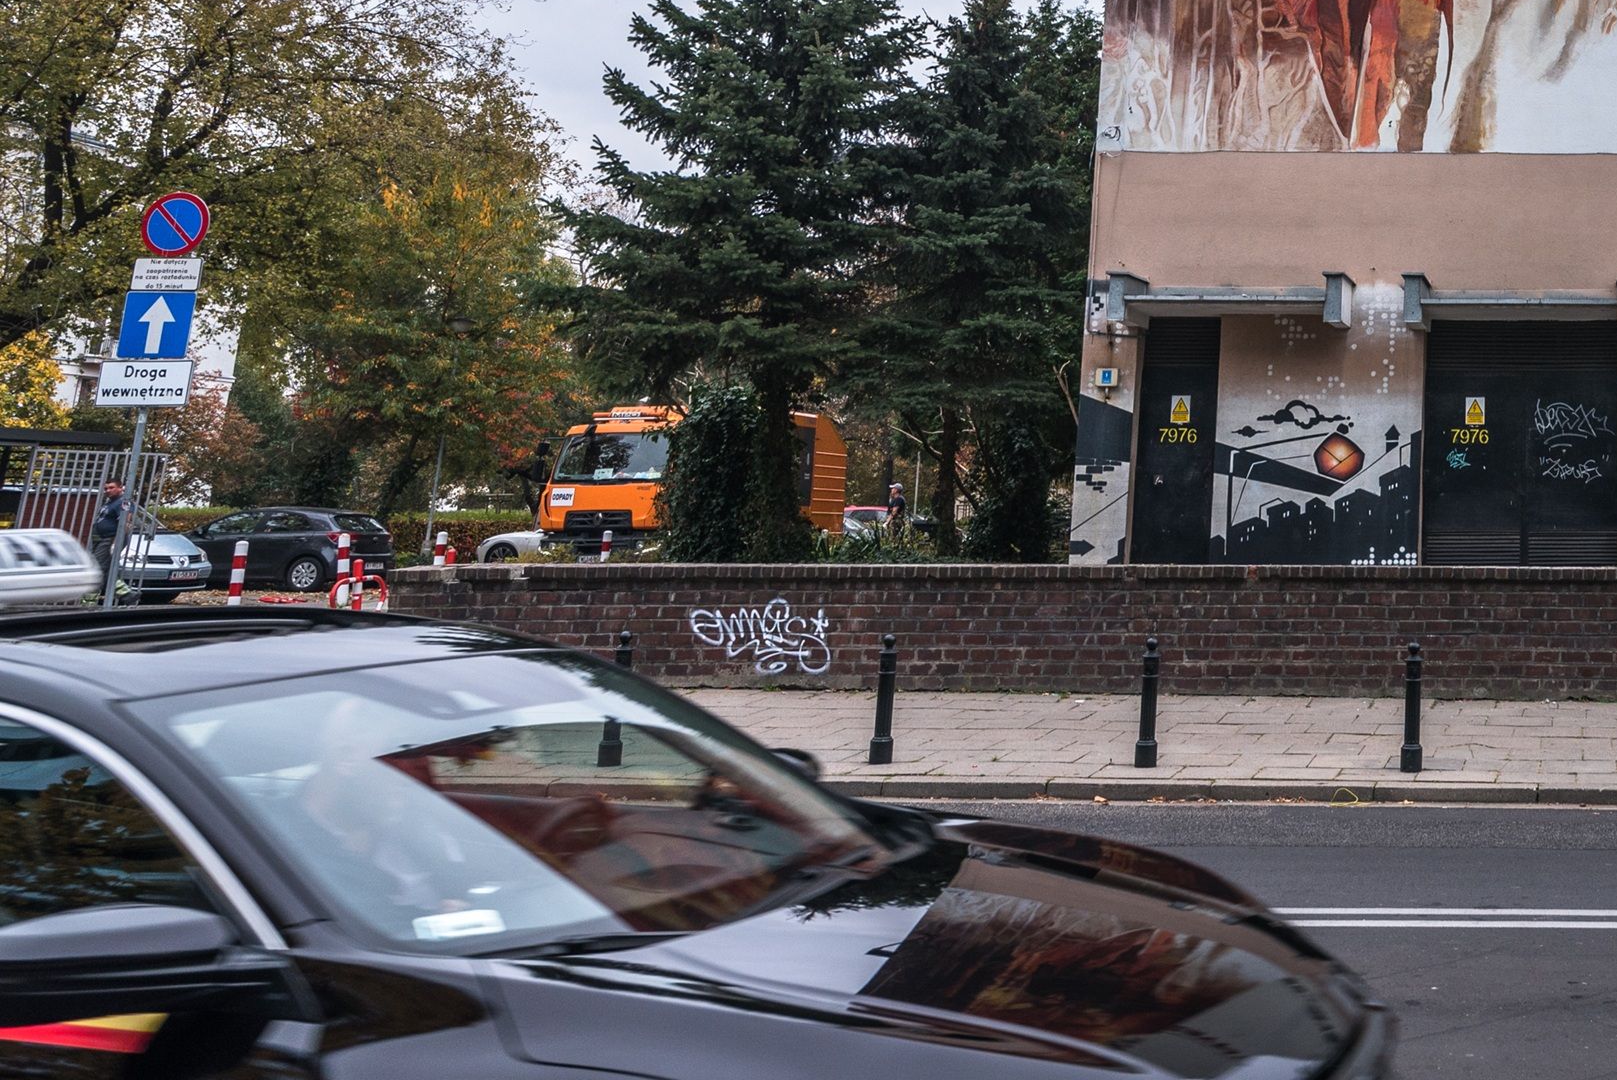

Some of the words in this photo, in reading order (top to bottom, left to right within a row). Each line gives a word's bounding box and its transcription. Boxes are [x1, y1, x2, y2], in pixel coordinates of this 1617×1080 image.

[124, 365, 167, 381] Droga
[101, 385, 184, 400] wewnętrzna
[1159, 427, 1197, 444] 7976
[1450, 428, 1489, 444] 7976
[552, 493, 573, 501] ODPADY
